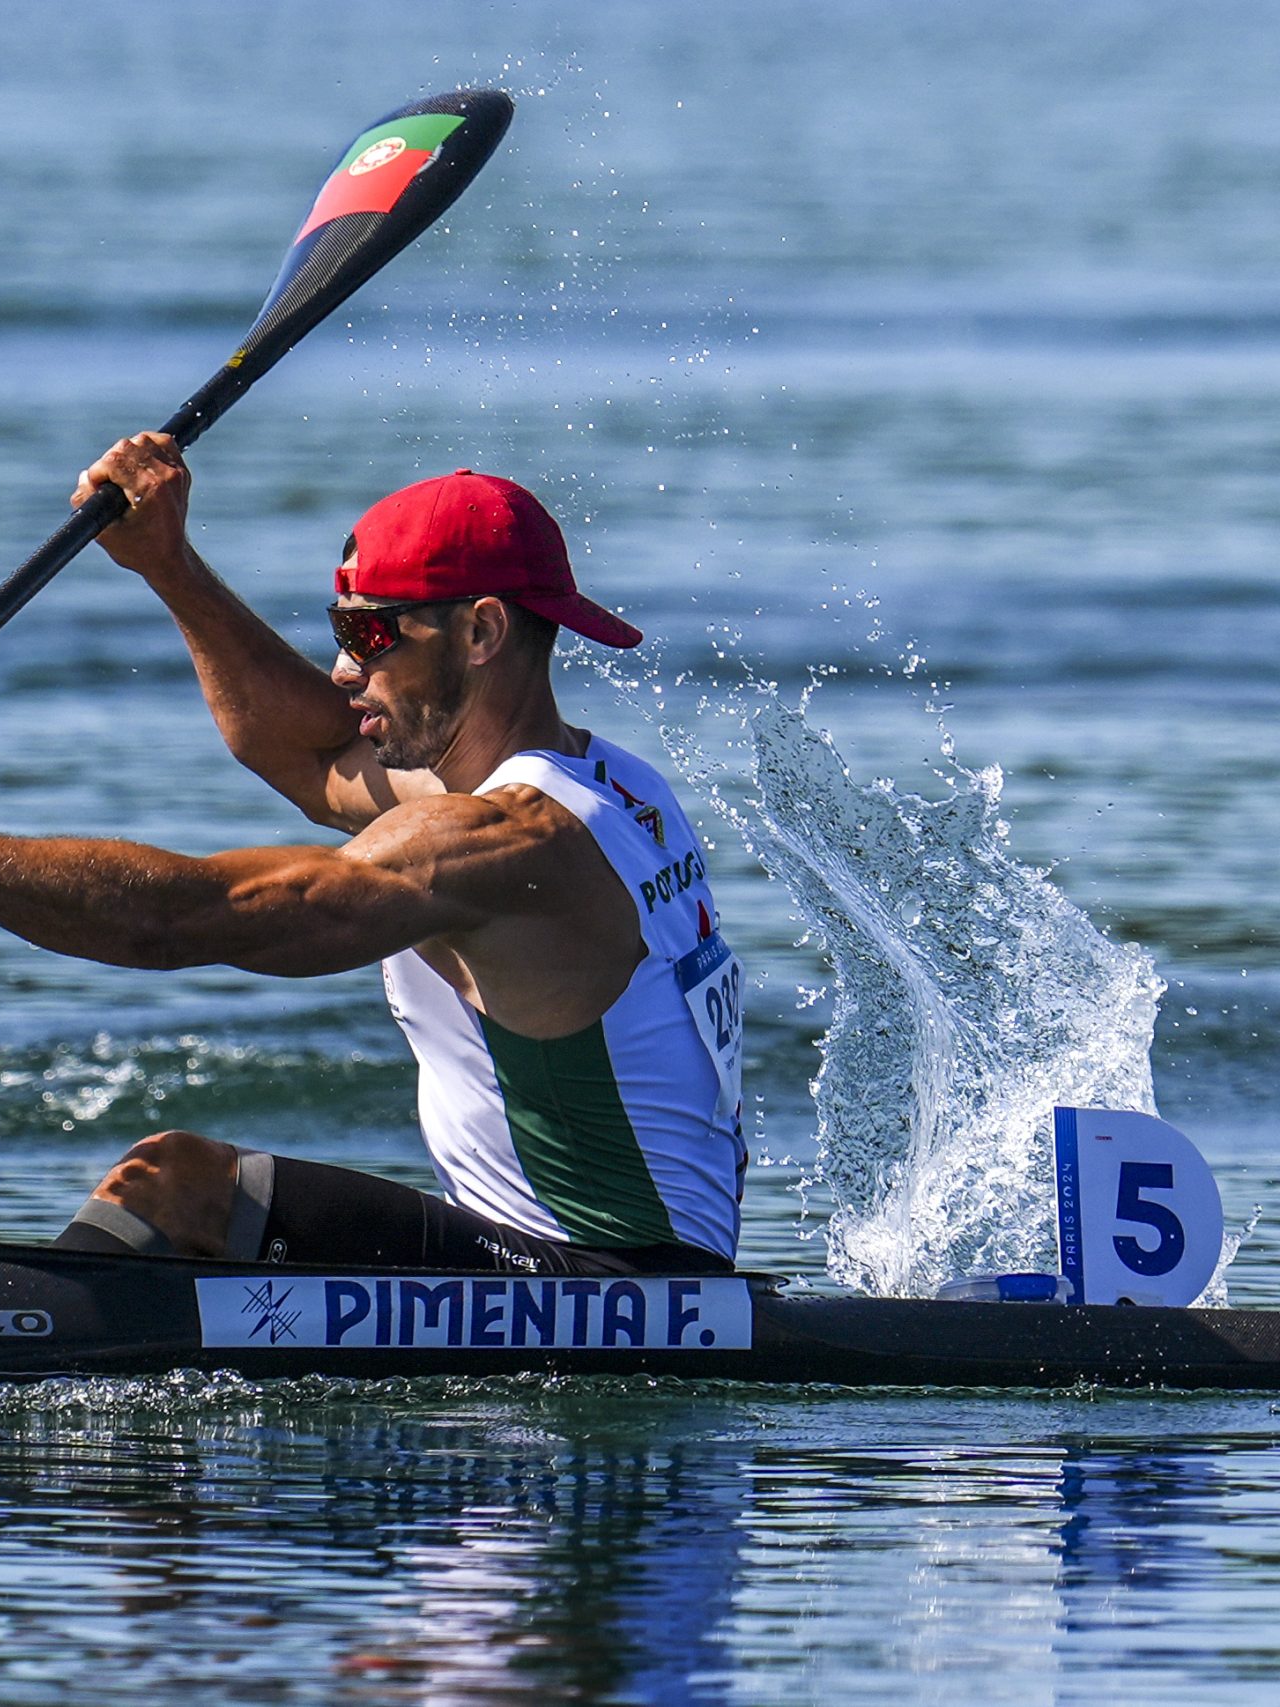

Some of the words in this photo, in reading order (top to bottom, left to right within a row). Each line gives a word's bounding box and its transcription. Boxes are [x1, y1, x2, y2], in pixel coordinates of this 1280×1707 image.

[1062, 1162, 1073, 1209] 2024
[1064, 1215, 1076, 1266] PARIS
[1112, 1161, 1185, 1277] 5
[324, 1280, 646, 1347] PIMENTA
[667, 1280, 716, 1347] F.
